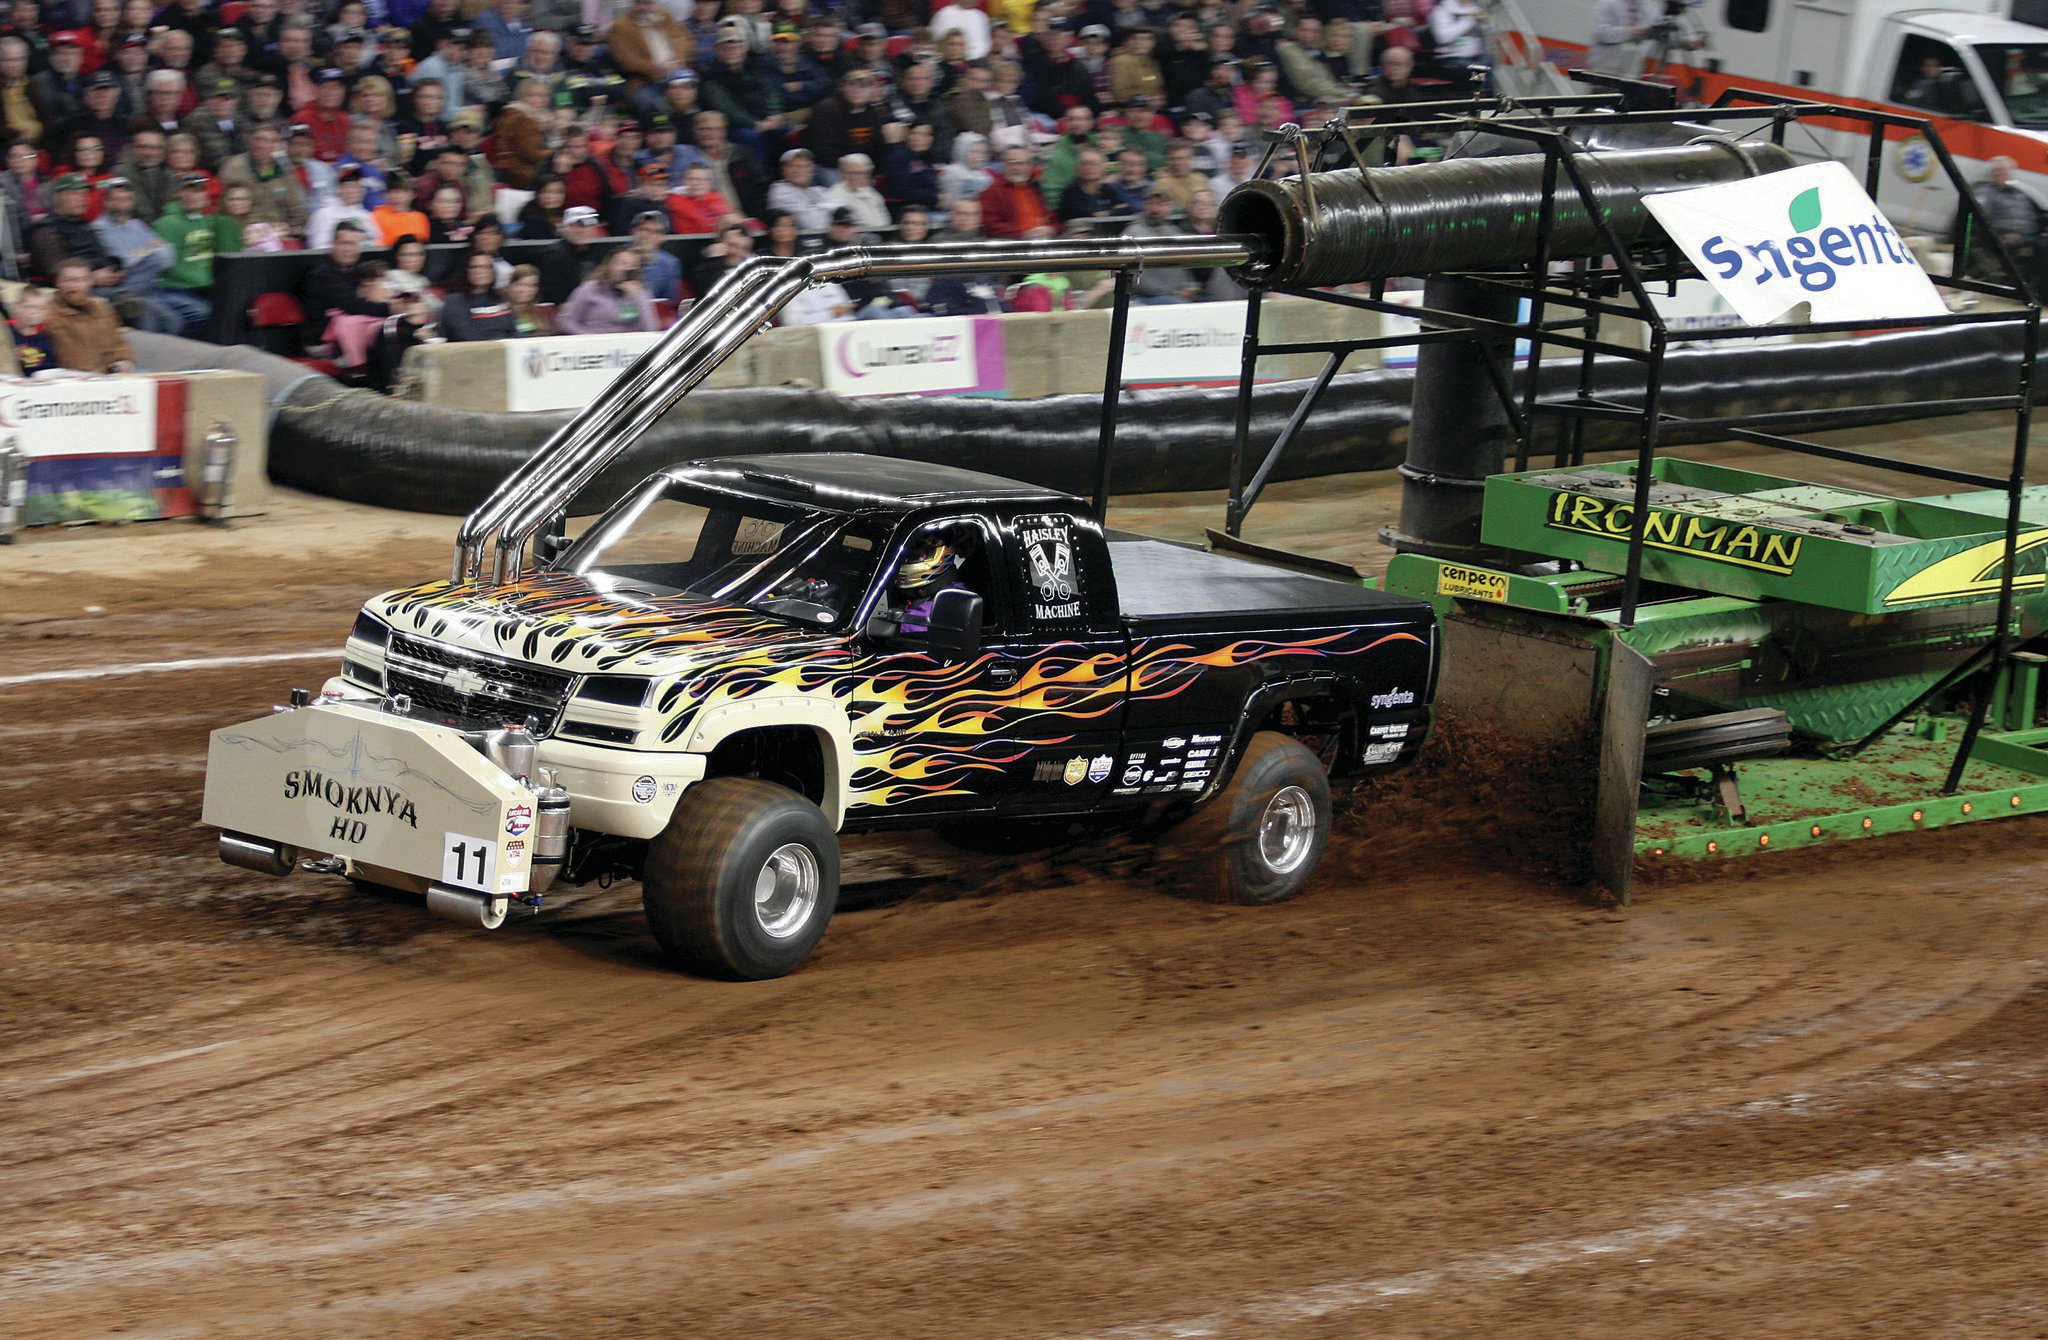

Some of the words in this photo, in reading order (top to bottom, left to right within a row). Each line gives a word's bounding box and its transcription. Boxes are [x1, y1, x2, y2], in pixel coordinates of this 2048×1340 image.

[1022, 525, 1070, 549] HAISLEY
[1551, 492, 1803, 567] IRONMAN
[1442, 566, 1506, 589] cenpeco
[1443, 583, 1495, 599] LUBRICANTS
[1034, 601, 1081, 619] MACHINE
[1370, 690, 1414, 709] syngenta
[1187, 749, 1212, 758] CASE
[1183, 770, 1211, 778] GEICO
[284, 768, 418, 829] SMOKNYA
[329, 815, 368, 844] HD
[451, 841, 487, 885] 11
